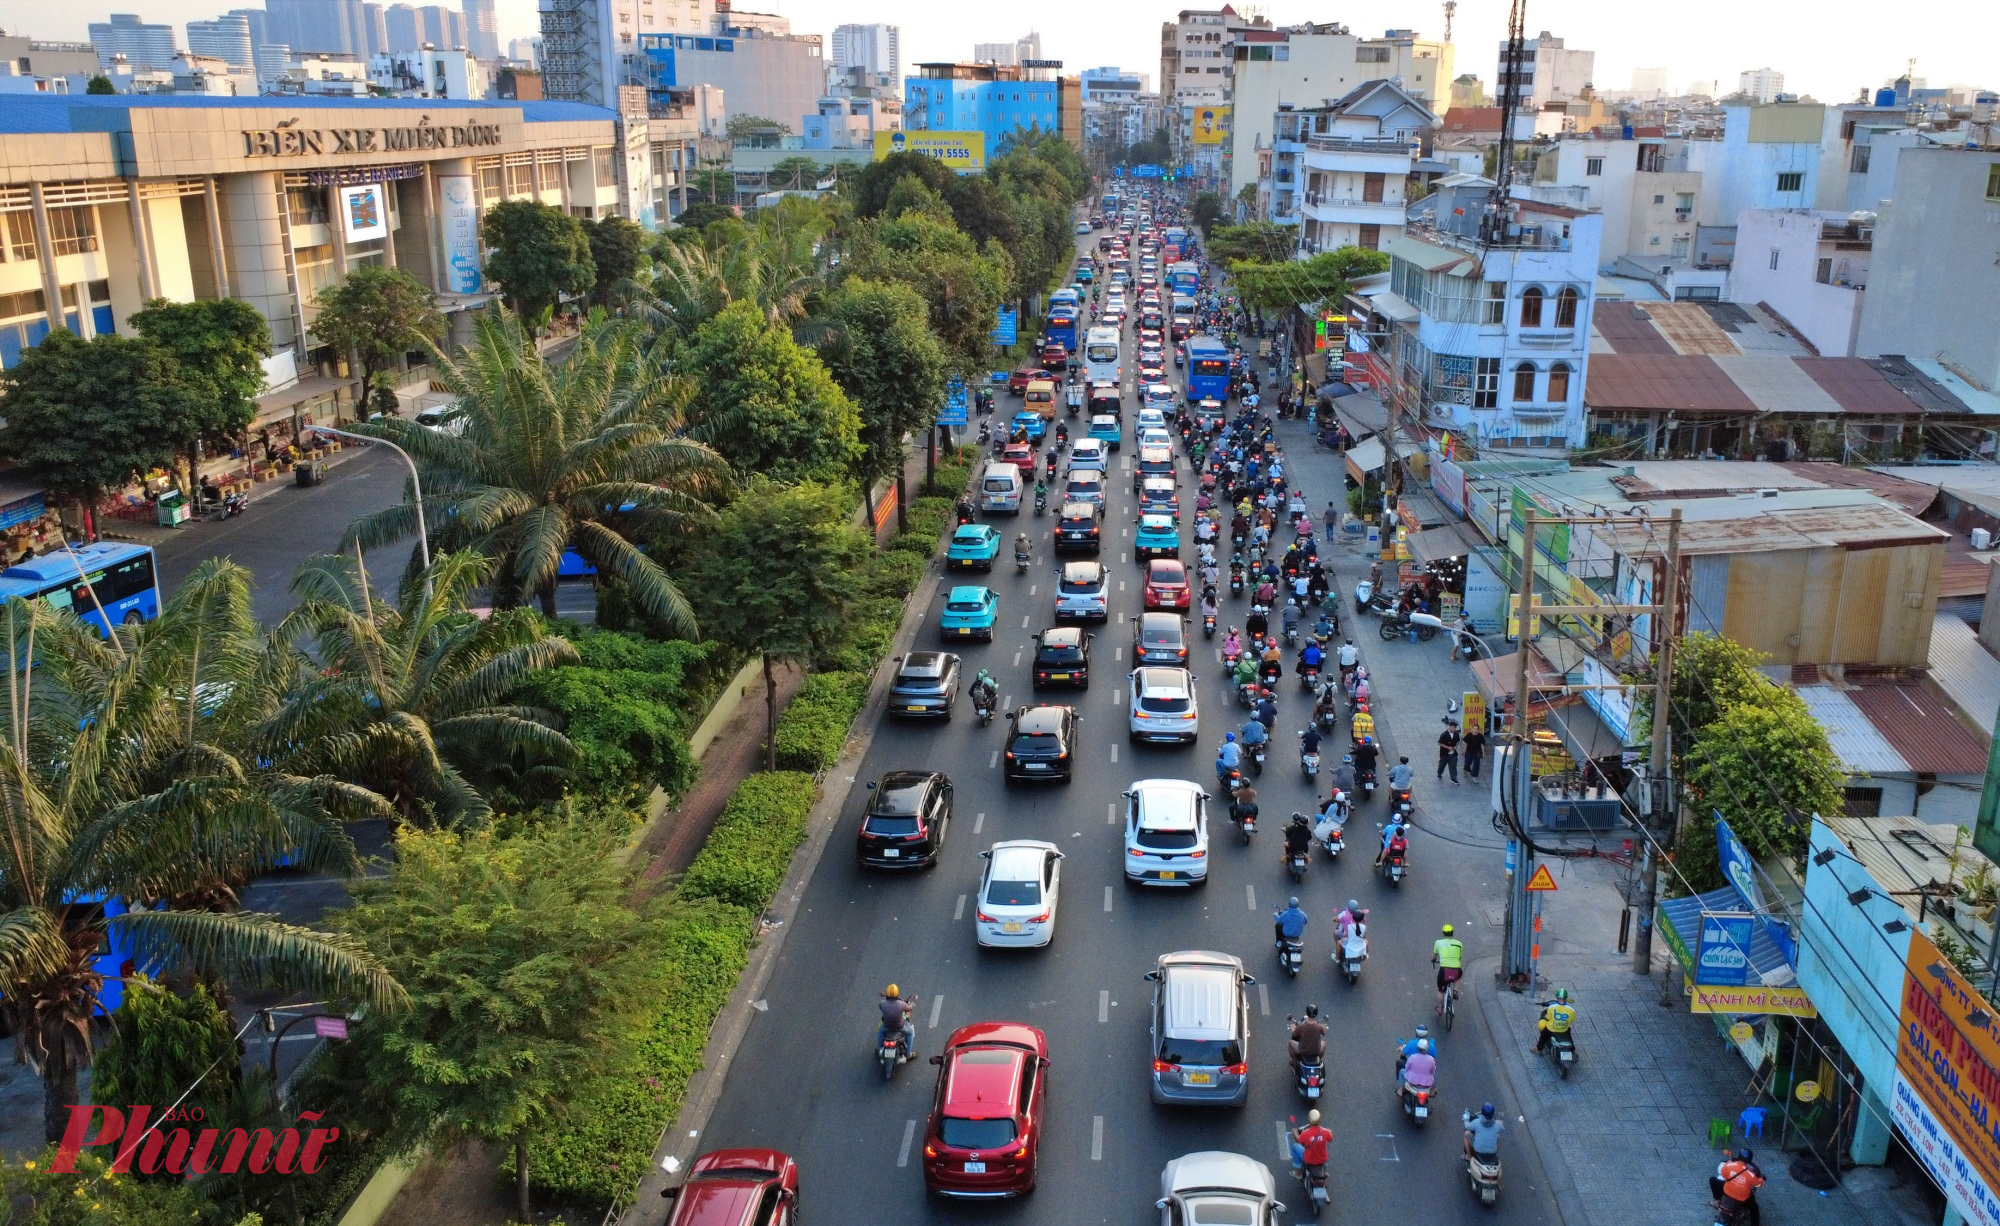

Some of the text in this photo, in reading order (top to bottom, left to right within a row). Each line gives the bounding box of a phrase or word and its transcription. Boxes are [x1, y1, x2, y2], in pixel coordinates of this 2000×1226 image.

[241, 114, 502, 158] BẾN XE MIỀN ĐÔNG
[1698, 991, 1813, 1008] BÁNH MÌ CHAY
[1958, 988, 1970, 1010] TY
[1972, 1002, 1990, 1034] VN
[1909, 1022, 1930, 1062] SÀI
[1932, 1049, 1959, 1098] GÒN
[1970, 1092, 1988, 1134] HÀ
[1895, 1100, 1904, 1114] XE
[1922, 1134, 1934, 1156] 10H
[1955, 1178, 1968, 1202] 20H
[1898, 1082, 1920, 1118] QUẢNG
[1920, 1109, 1938, 1142] NINH
[1942, 1142, 1953, 1162] HÀ
[1955, 1156, 1970, 1182] NỘI
[1974, 1180, 1985, 1205] HÀ
